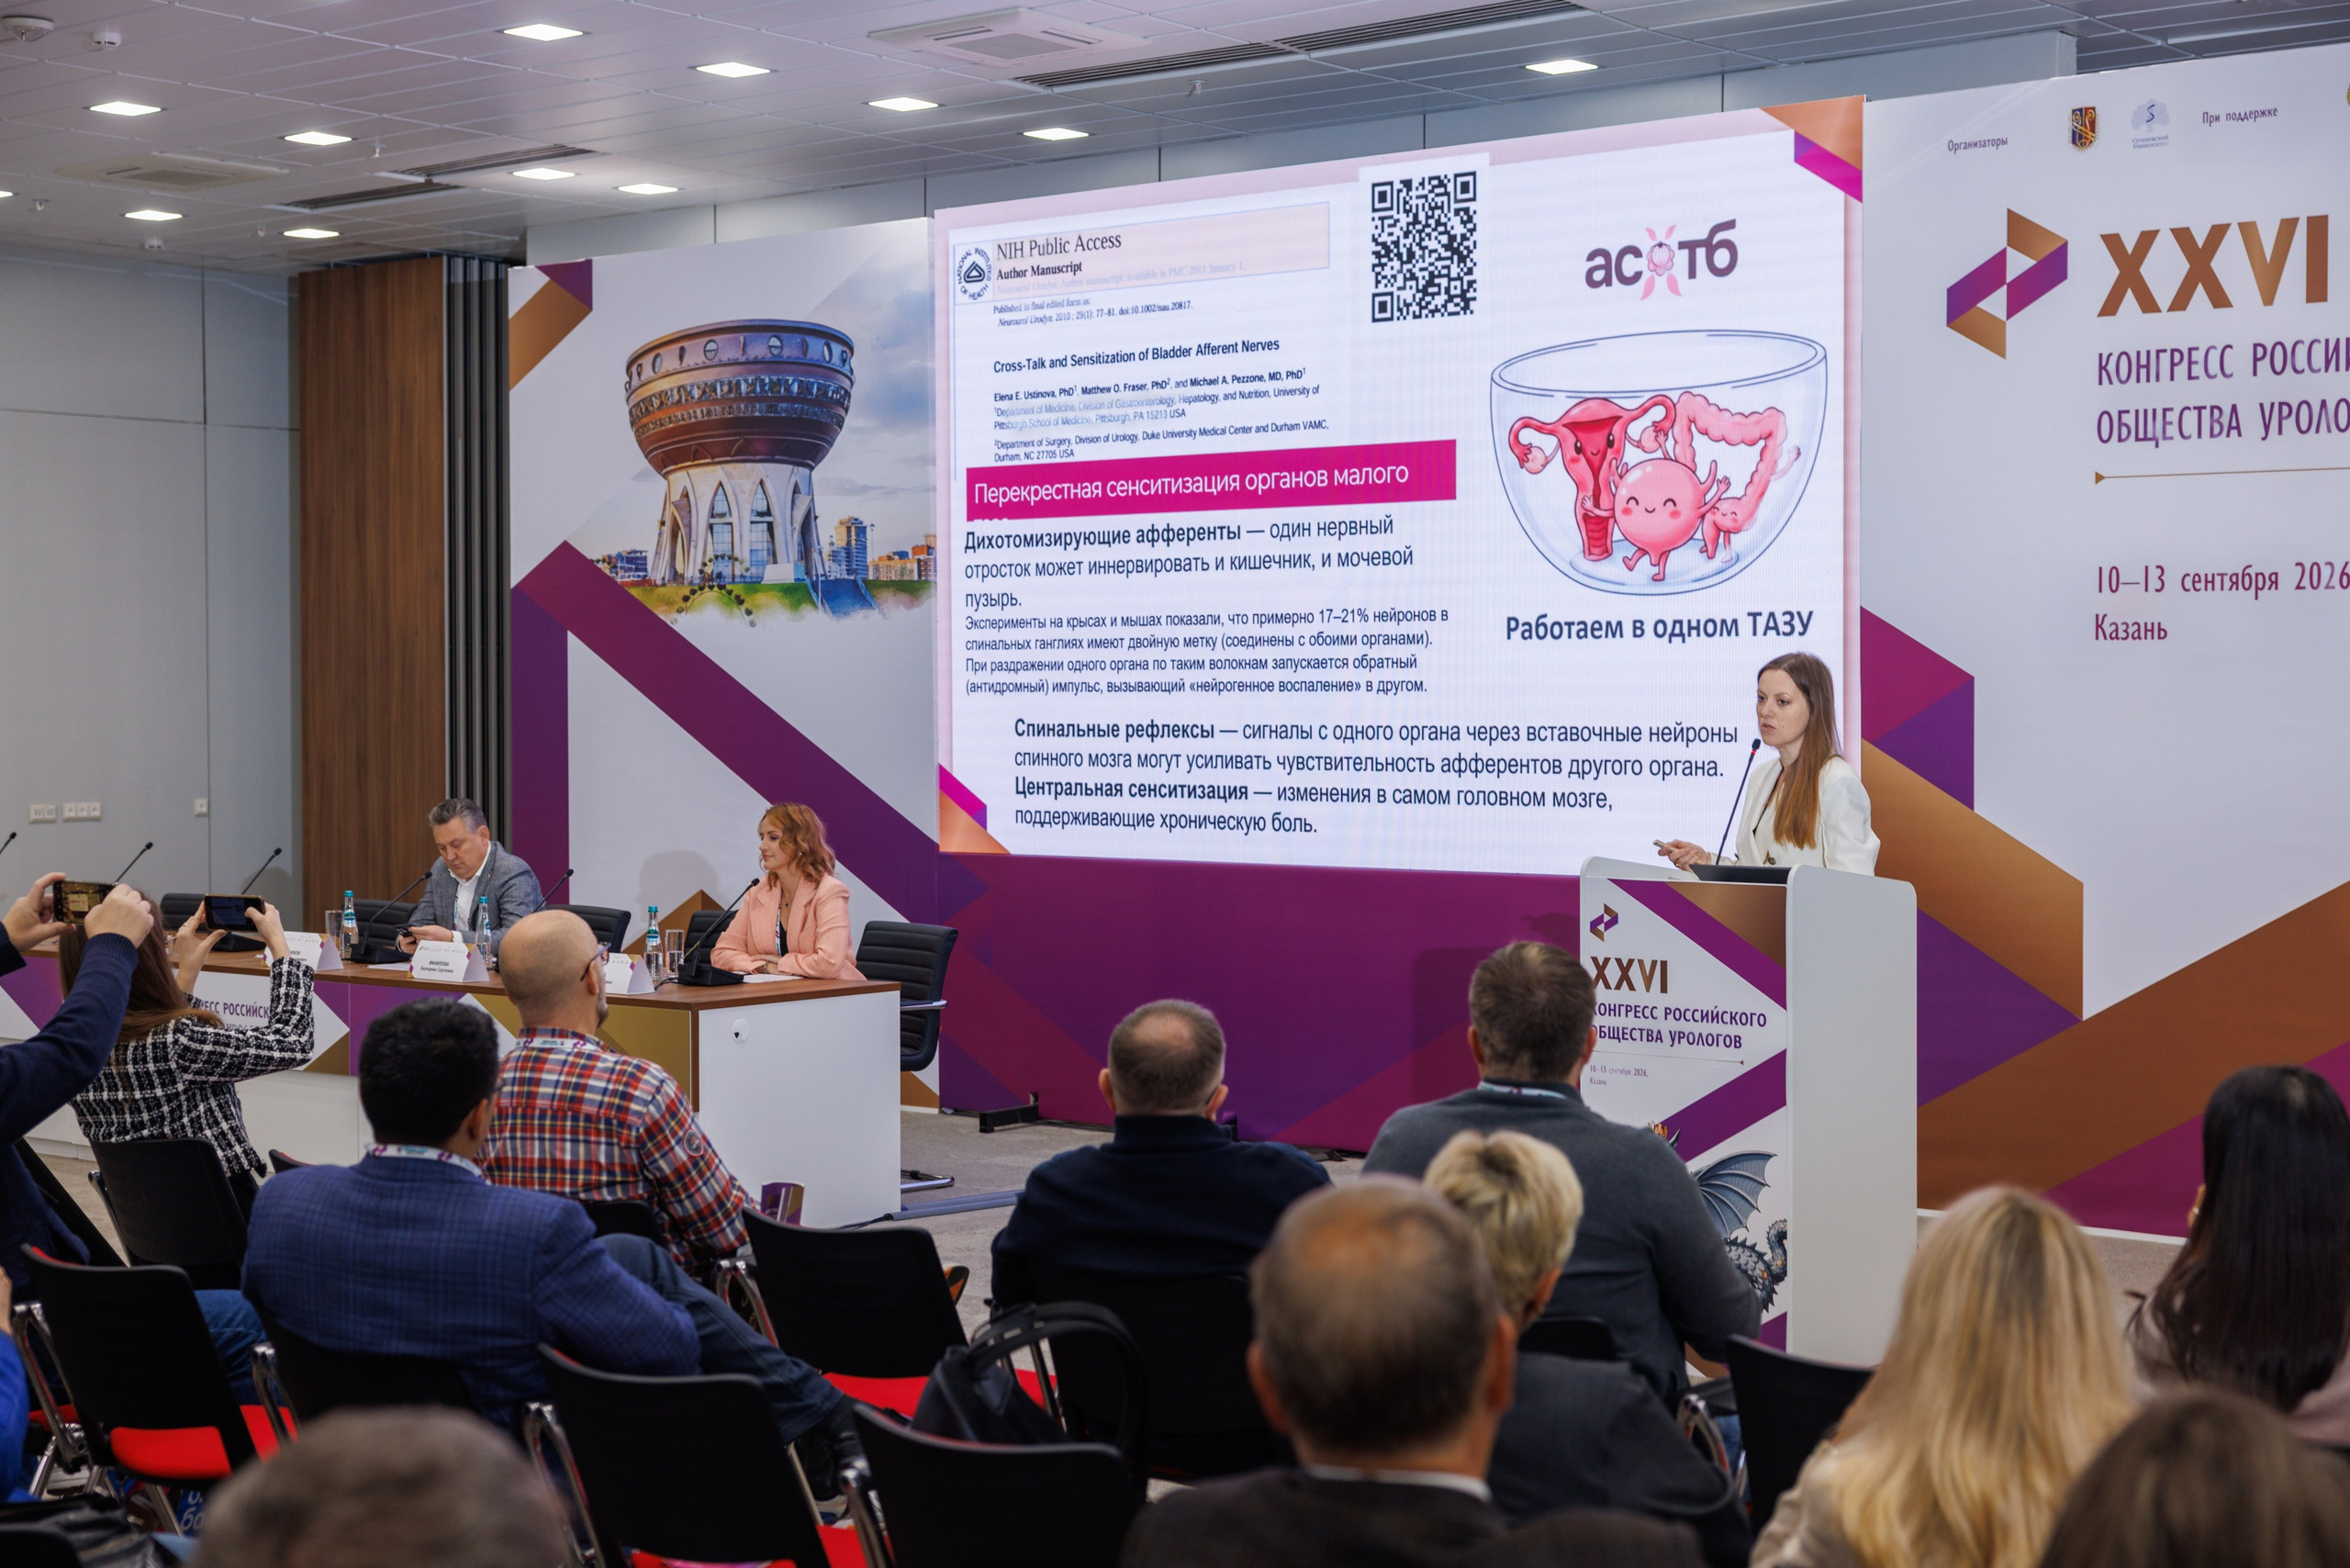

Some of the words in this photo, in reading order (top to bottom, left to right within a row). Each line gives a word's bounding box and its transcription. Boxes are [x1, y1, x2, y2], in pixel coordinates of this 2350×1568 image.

[2202, 111, 2221, 127] При
[2226, 106, 2278, 124] поддержке
[1947, 135, 2009, 152] Организаторы
[997, 241, 1024, 260] NIH
[1029, 237, 1070, 258] Public
[1074, 234, 1122, 252] Access
[996, 266, 1029, 281] Author
[1030, 261, 1083, 277] Manuscript
[2097, 214, 2329, 319] XXVI
[993, 355, 1046, 374] Cross-Talk
[1048, 353, 1068, 369] and
[1069, 350, 1136, 367] Sensitization
[1137, 347, 1149, 362] of
[1151, 344, 1193, 361] Bladder
[1195, 341, 1239, 357] Afferent
[1241, 338, 1281, 353] Nerves
[2098, 343, 2234, 386] КОНГРЕСС
[2097, 403, 2243, 448] ОБЩЕСТВА
[974, 480, 1102, 509] Перекрестная
[1106, 474, 1240, 498] сенситизация
[1245, 469, 1329, 496] органов
[1334, 465, 1409, 487] малого
[964, 529, 1132, 554] Дихотомизирующие
[1136, 522, 1241, 549] афференты
[1269, 521, 1312, 543] один
[1316, 513, 1393, 542] нервный
[964, 562, 1032, 584] отросток
[1035, 560, 1084, 577] может
[1088, 556, 1211, 579] иннервировать
[1214, 555, 1225, 572] и
[1229, 553, 1315, 572] кишечник,
[1321, 552, 1332, 568] и
[1337, 544, 1414, 568] мочевой
[2181, 564, 2279, 600] сентября
[2294, 561, 2350, 591] 2026
[965, 591, 1023, 613] пузырь.
[965, 615, 1046, 633] Эксперименты
[1049, 616, 1064, 629] на
[1066, 616, 1107, 632] крысах
[1110, 615, 1118, 628] и
[1120, 614, 1163, 628] мышах
[1165, 613, 1225, 627] показали,
[1227, 612, 1249, 625] что
[1252, 611, 1315, 629] примерно
[1372, 607, 1438, 627] нейронов
[1440, 609, 1449, 622] в
[1506, 612, 1625, 642] Работаем
[1631, 619, 1646, 639] в
[1652, 617, 1740, 644] одном
[1746, 610, 1814, 638] ТАЗУ
[2095, 613, 2168, 641] Казань
[965, 639, 1032, 652] спинальных
[1035, 637, 1084, 651] ганглиях
[1087, 637, 1125, 650] имеют
[1127, 633, 1181, 653] двойную
[1182, 635, 1218, 652] метку
[1221, 633, 1295, 652] (соединены
[1297, 634, 1306, 647] с
[1308, 630, 1358, 647] обоими
[1360, 629, 1433, 650] органами).
[966, 657, 988, 676] При
[990, 660, 1065, 676] раздражении
[1067, 659, 1107, 674] одного
[1109, 658, 1149, 675] органа
[1152, 658, 1168, 671] по
[1169, 658, 1205, 671] таким
[1208, 657, 1269, 671] волокнам
[1271, 656, 1349, 674] запускается
[1352, 653, 1417, 674] обратный
[966, 678, 1049, 697] (антидромный)
[1052, 680, 1103, 697] импульс,
[1106, 678, 1186, 695] вызывающий
[1189, 678, 1275, 697] «нейрогенное
[1278, 679, 1361, 693] воспаление»
[1365, 679, 1374, 693] в
[1376, 679, 1427, 697] другом.
[1014, 717, 1121, 739] Спинальные
[1125, 718, 1214, 744] рефлексы
[1242, 723, 1313, 741] сигналы
[1317, 723, 1328, 741] с
[1332, 723, 1394, 745] одного
[1398, 724, 1461, 746] органа
[1466, 724, 1521, 747] через
[1526, 724, 1643, 743] вставочные
[1649, 721, 1738, 749] нейроны
[1014, 751, 1084, 768] спинного
[1088, 752, 1133, 769] мозга
[1136, 752, 1182, 774] могут
[1185, 753, 1272, 775] усиливать
[1276, 755, 1436, 777] чувствительность
[1440, 751, 1563, 779] афферентов
[1567, 757, 1643, 781] другого
[1649, 758, 1724, 782] органа.
[1014, 775, 1124, 801] Центральная
[1127, 782, 1248, 804] сенситизация
[1277, 785, 1371, 804] изменения
[1376, 788, 1387, 804] в
[1392, 788, 1451, 806] самом
[1457, 789, 1546, 808] головном
[1552, 790, 1613, 812] мозге,
[1014, 809, 1156, 832] поддерживающие
[1159, 812, 1267, 837] хроническую
[1270, 811, 1317, 834] боль.
[1590, 956, 1668, 994] XXVI
[223, 1002, 270, 1019] РОССИЙСК
[1663, 1005, 1768, 1028] РОССИЙСКОГО
[1669, 1029, 1742, 1049] УРОЛОГОВ
